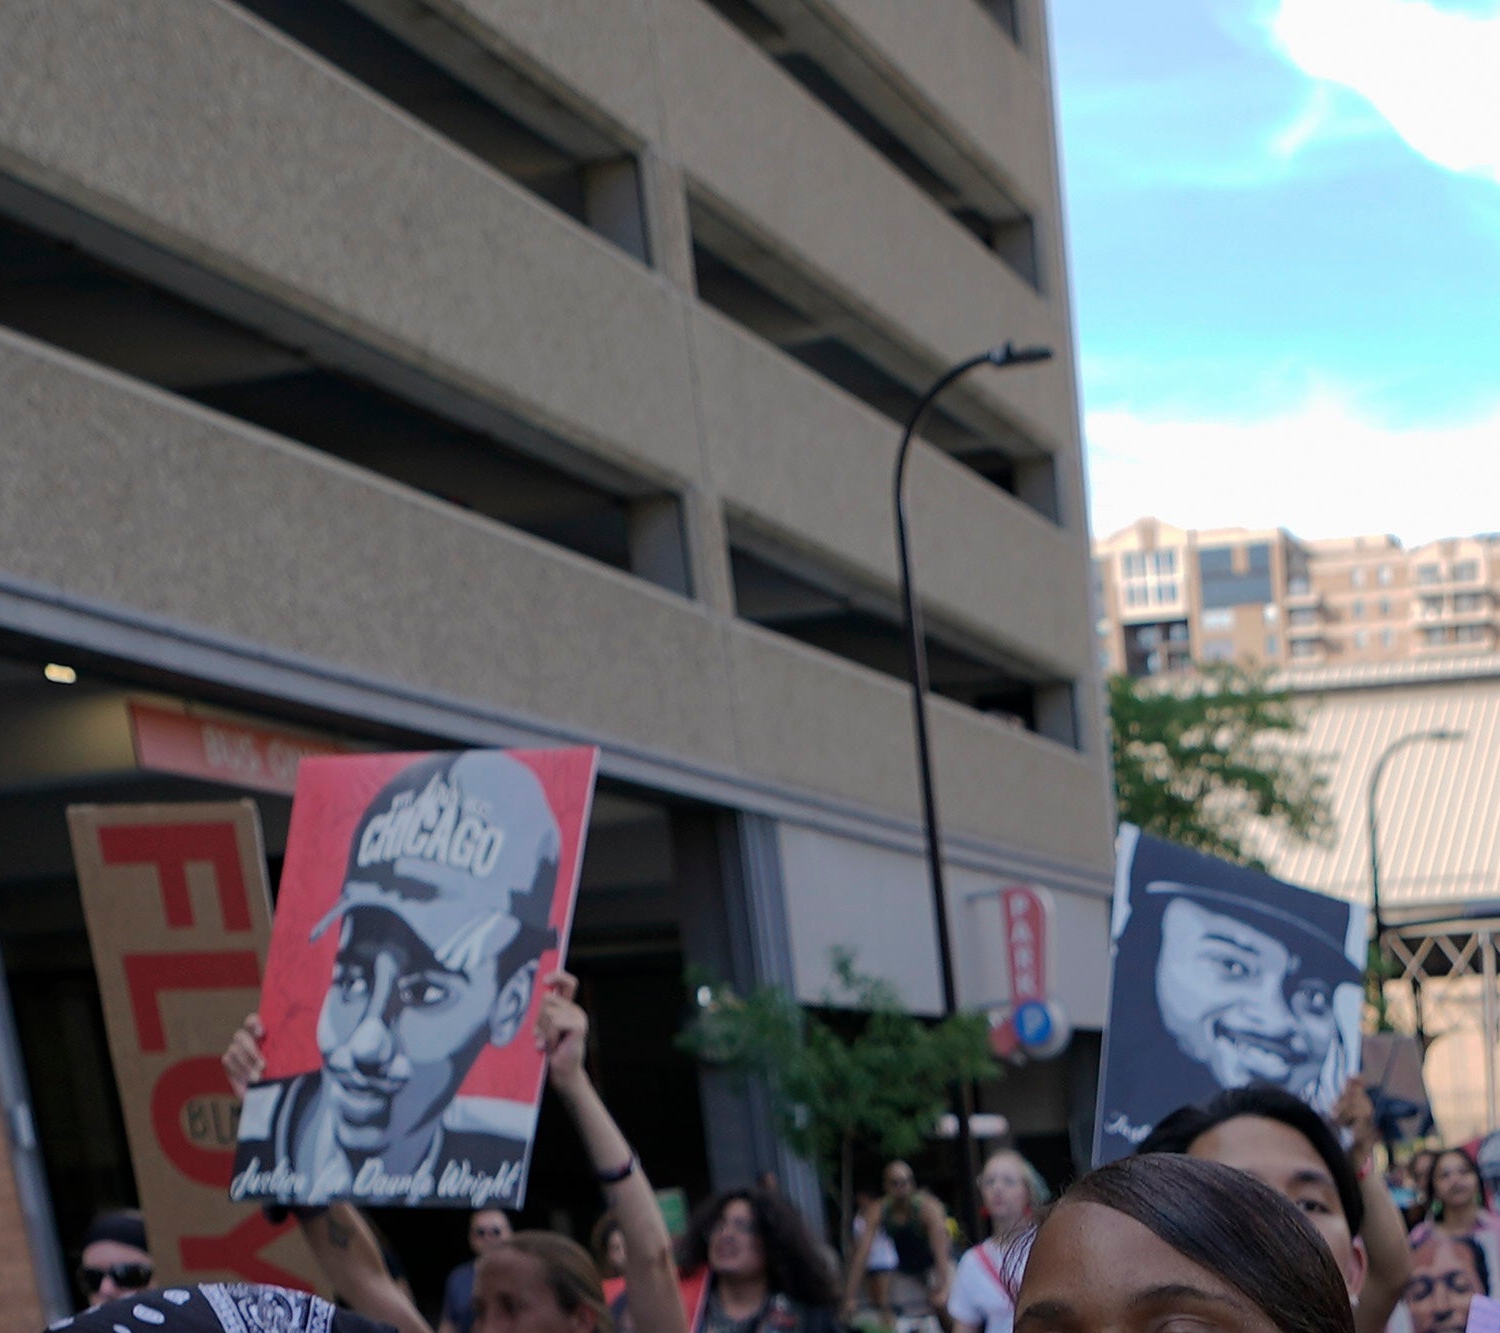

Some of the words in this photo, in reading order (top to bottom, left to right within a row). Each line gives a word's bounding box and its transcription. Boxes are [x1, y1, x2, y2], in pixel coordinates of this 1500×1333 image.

[357, 794, 505, 877] CHICAGO
[1009, 893, 1036, 995] PARK
[97, 822, 312, 1293] FLOY
[437, 1158, 523, 1208] Wright
